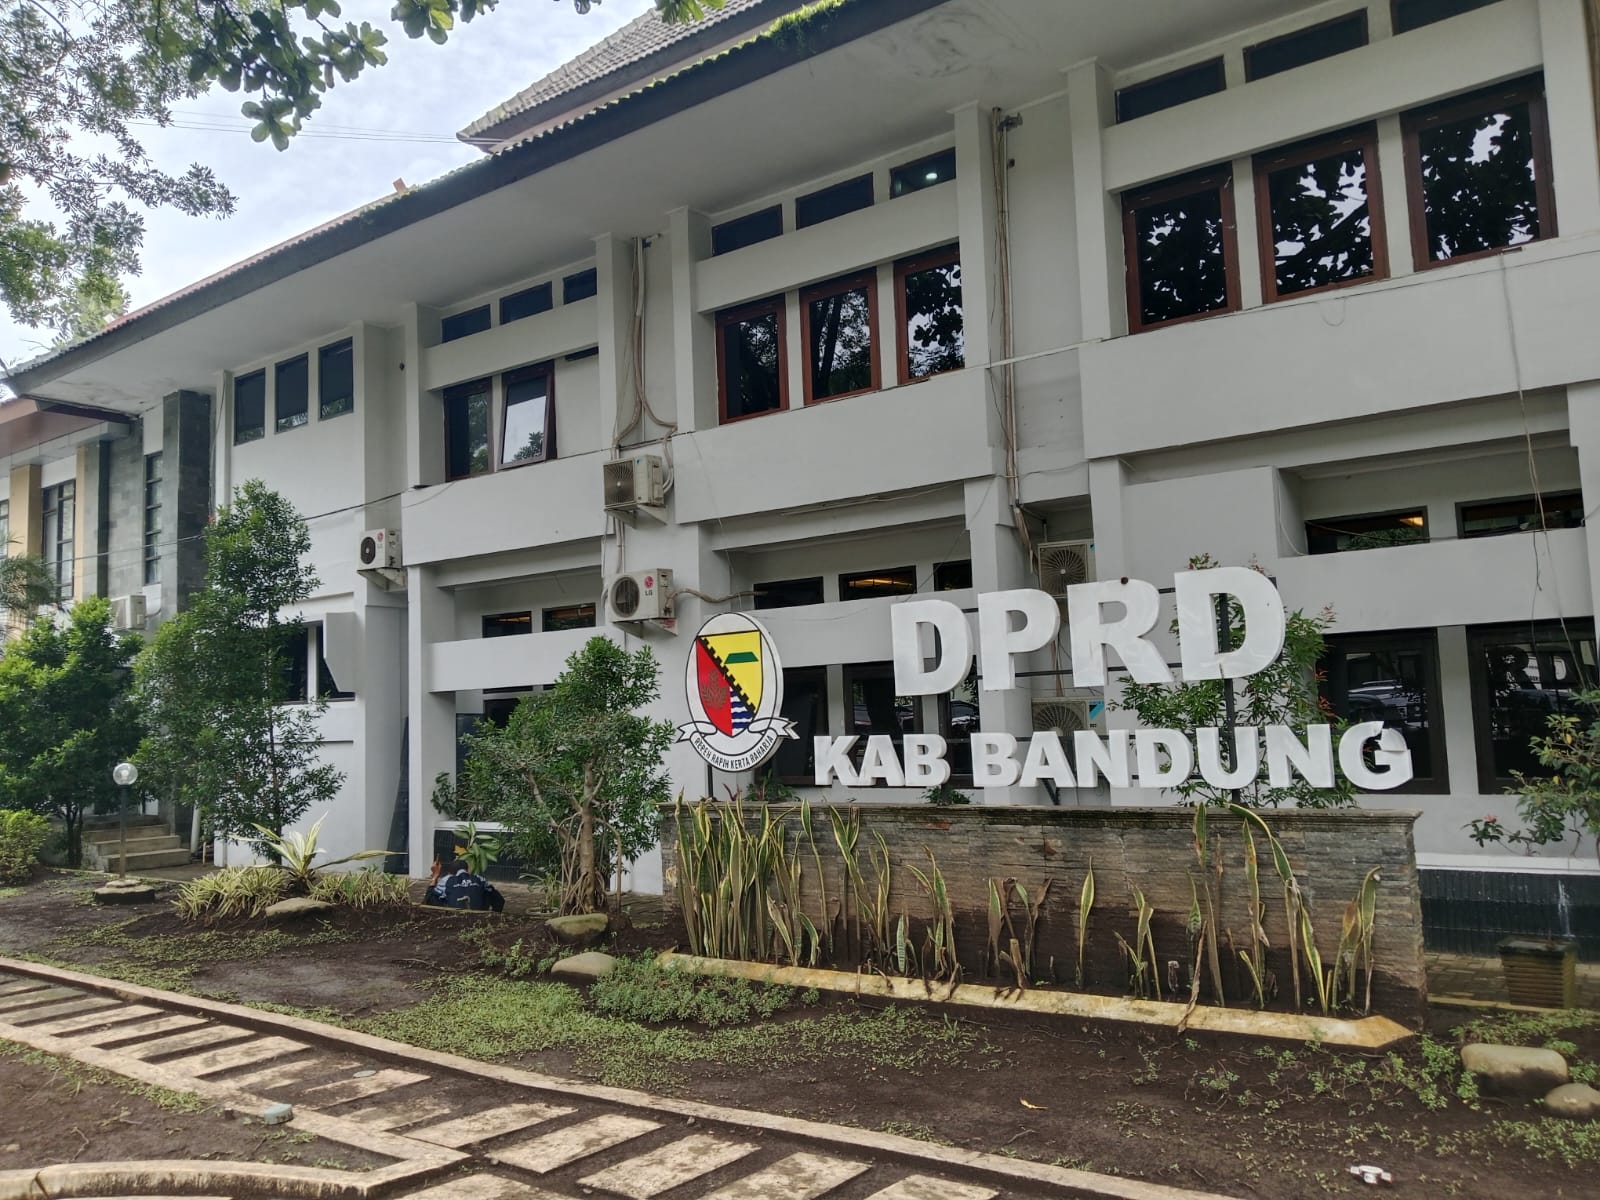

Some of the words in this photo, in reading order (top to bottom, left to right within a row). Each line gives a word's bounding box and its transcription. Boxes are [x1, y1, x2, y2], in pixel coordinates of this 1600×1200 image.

[891, 566, 1285, 697] DPRD
[730, 757, 751, 770] KERTA
[813, 733, 951, 787] KAB
[970, 721, 1414, 790] BANDUNG
